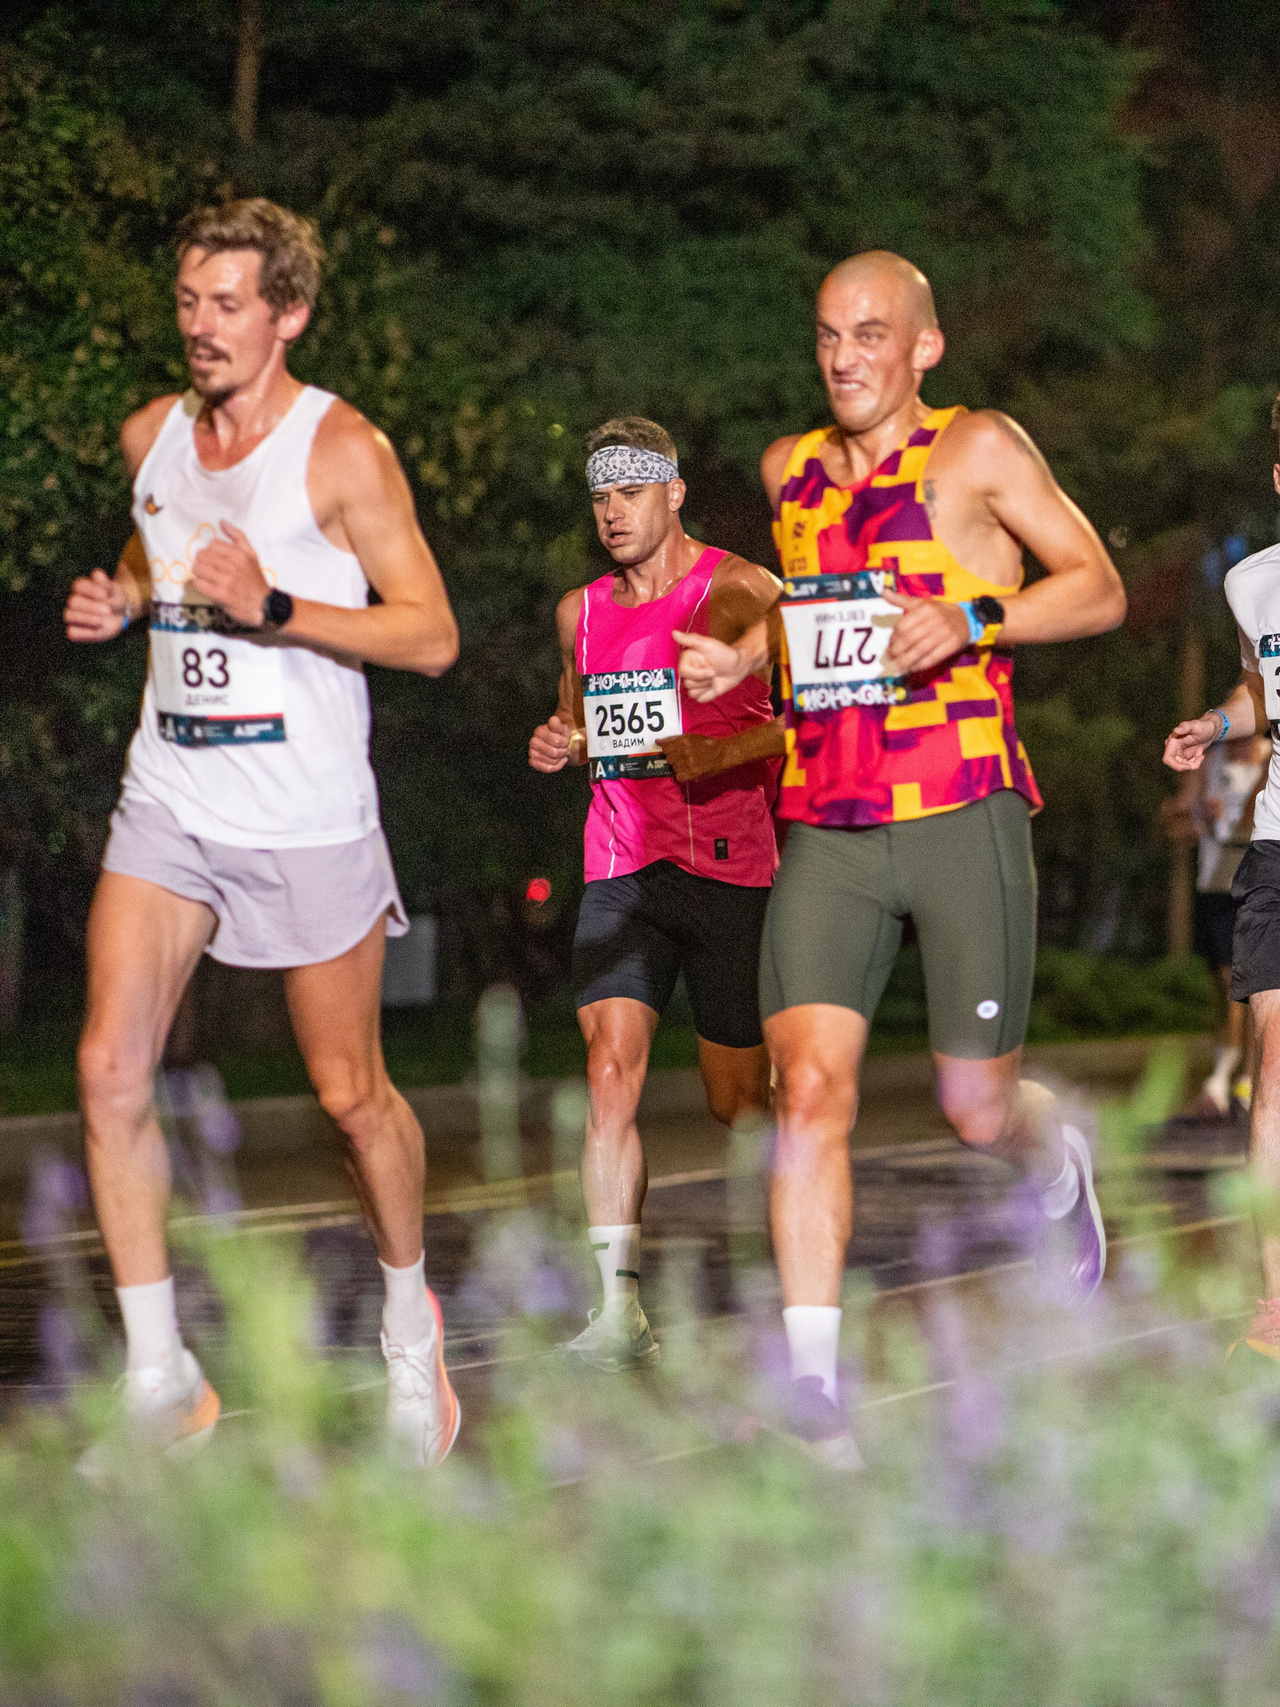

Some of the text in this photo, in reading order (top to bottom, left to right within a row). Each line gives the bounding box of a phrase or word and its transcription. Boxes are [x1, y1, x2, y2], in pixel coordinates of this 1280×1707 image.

[814, 627, 877, 669] 277
[182, 647, 230, 689] 83
[185, 694, 230, 706] ДЕНИС
[595, 700, 665, 737] 2565
[612, 737, 645, 749] ВАДИМ
